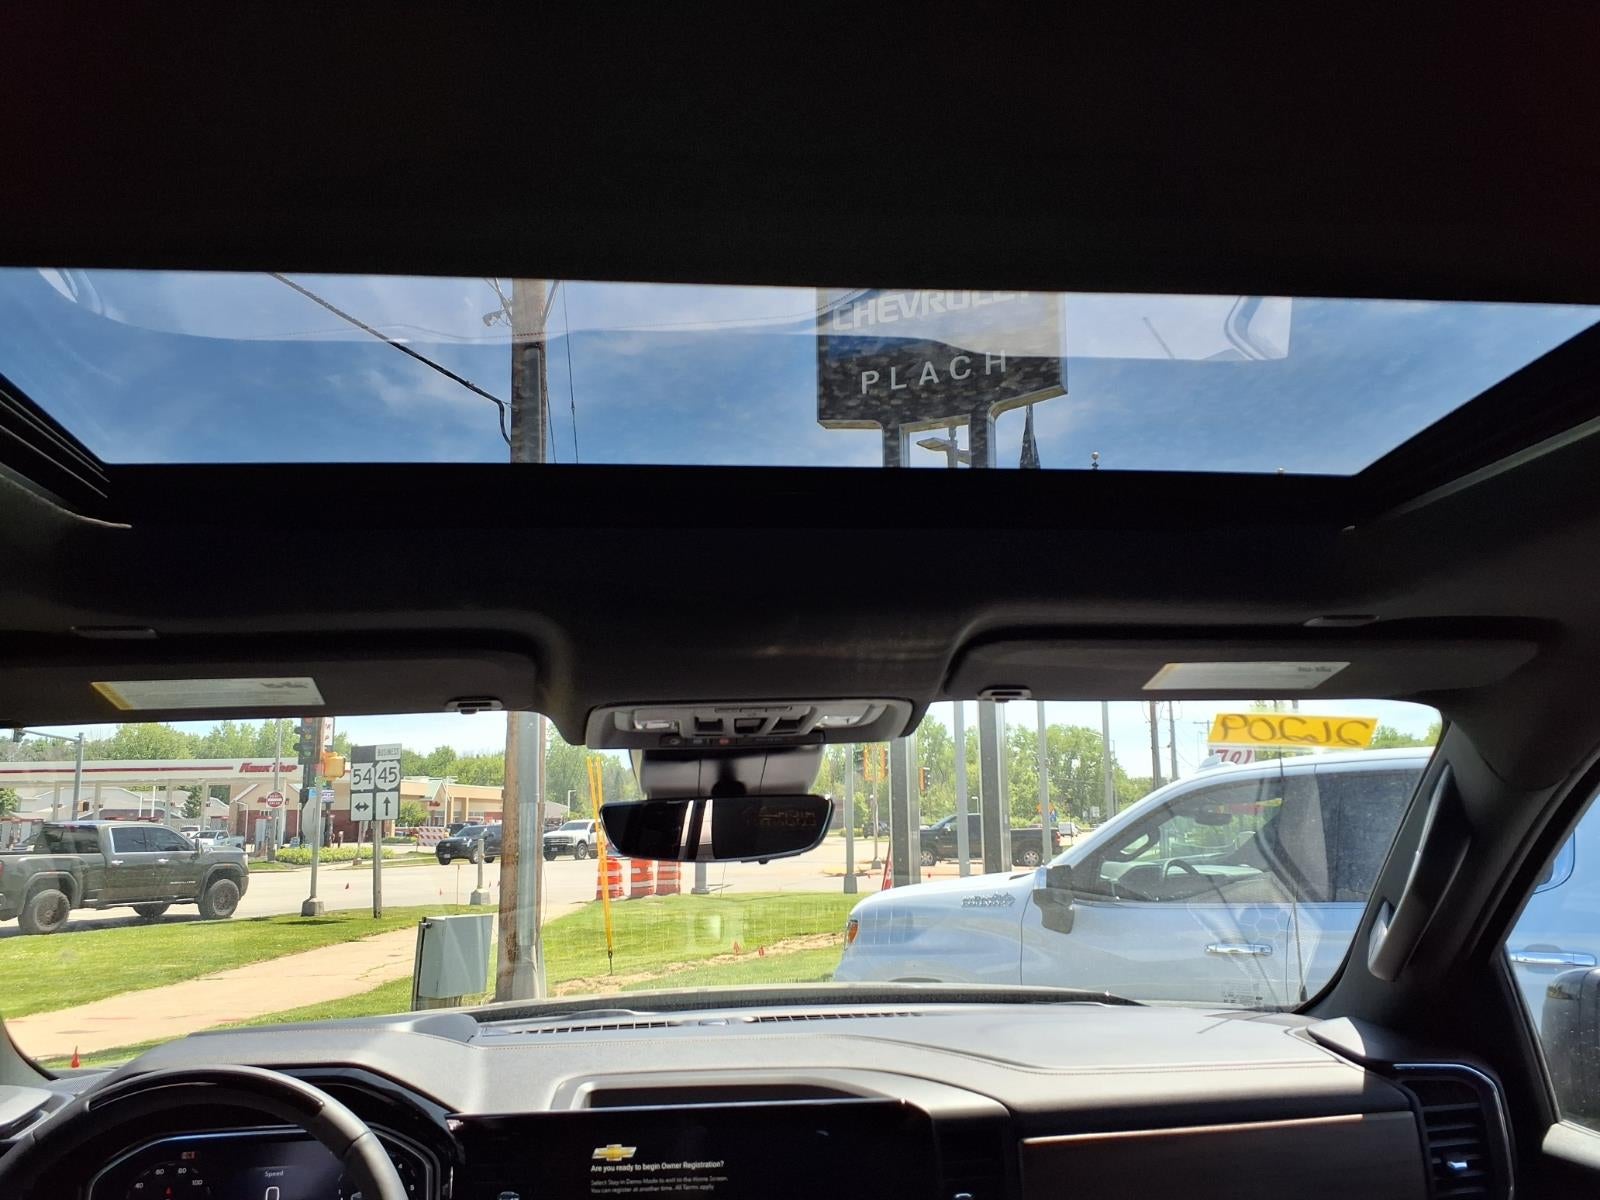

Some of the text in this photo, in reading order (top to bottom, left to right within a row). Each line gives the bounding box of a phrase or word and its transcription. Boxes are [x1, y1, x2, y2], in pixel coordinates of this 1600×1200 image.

[860, 349, 1007, 395] PLACH
[352, 768, 373, 785] 54
[377, 766, 398, 783] 45
[265, 1170, 284, 1178] Speed
[603, 1165, 615, 1173] you
[616, 1164, 634, 1172] ready
[642, 1163, 660, 1172] begin
[661, 1162, 682, 1170] Owner
[683, 1160, 725, 1170] Registration?
